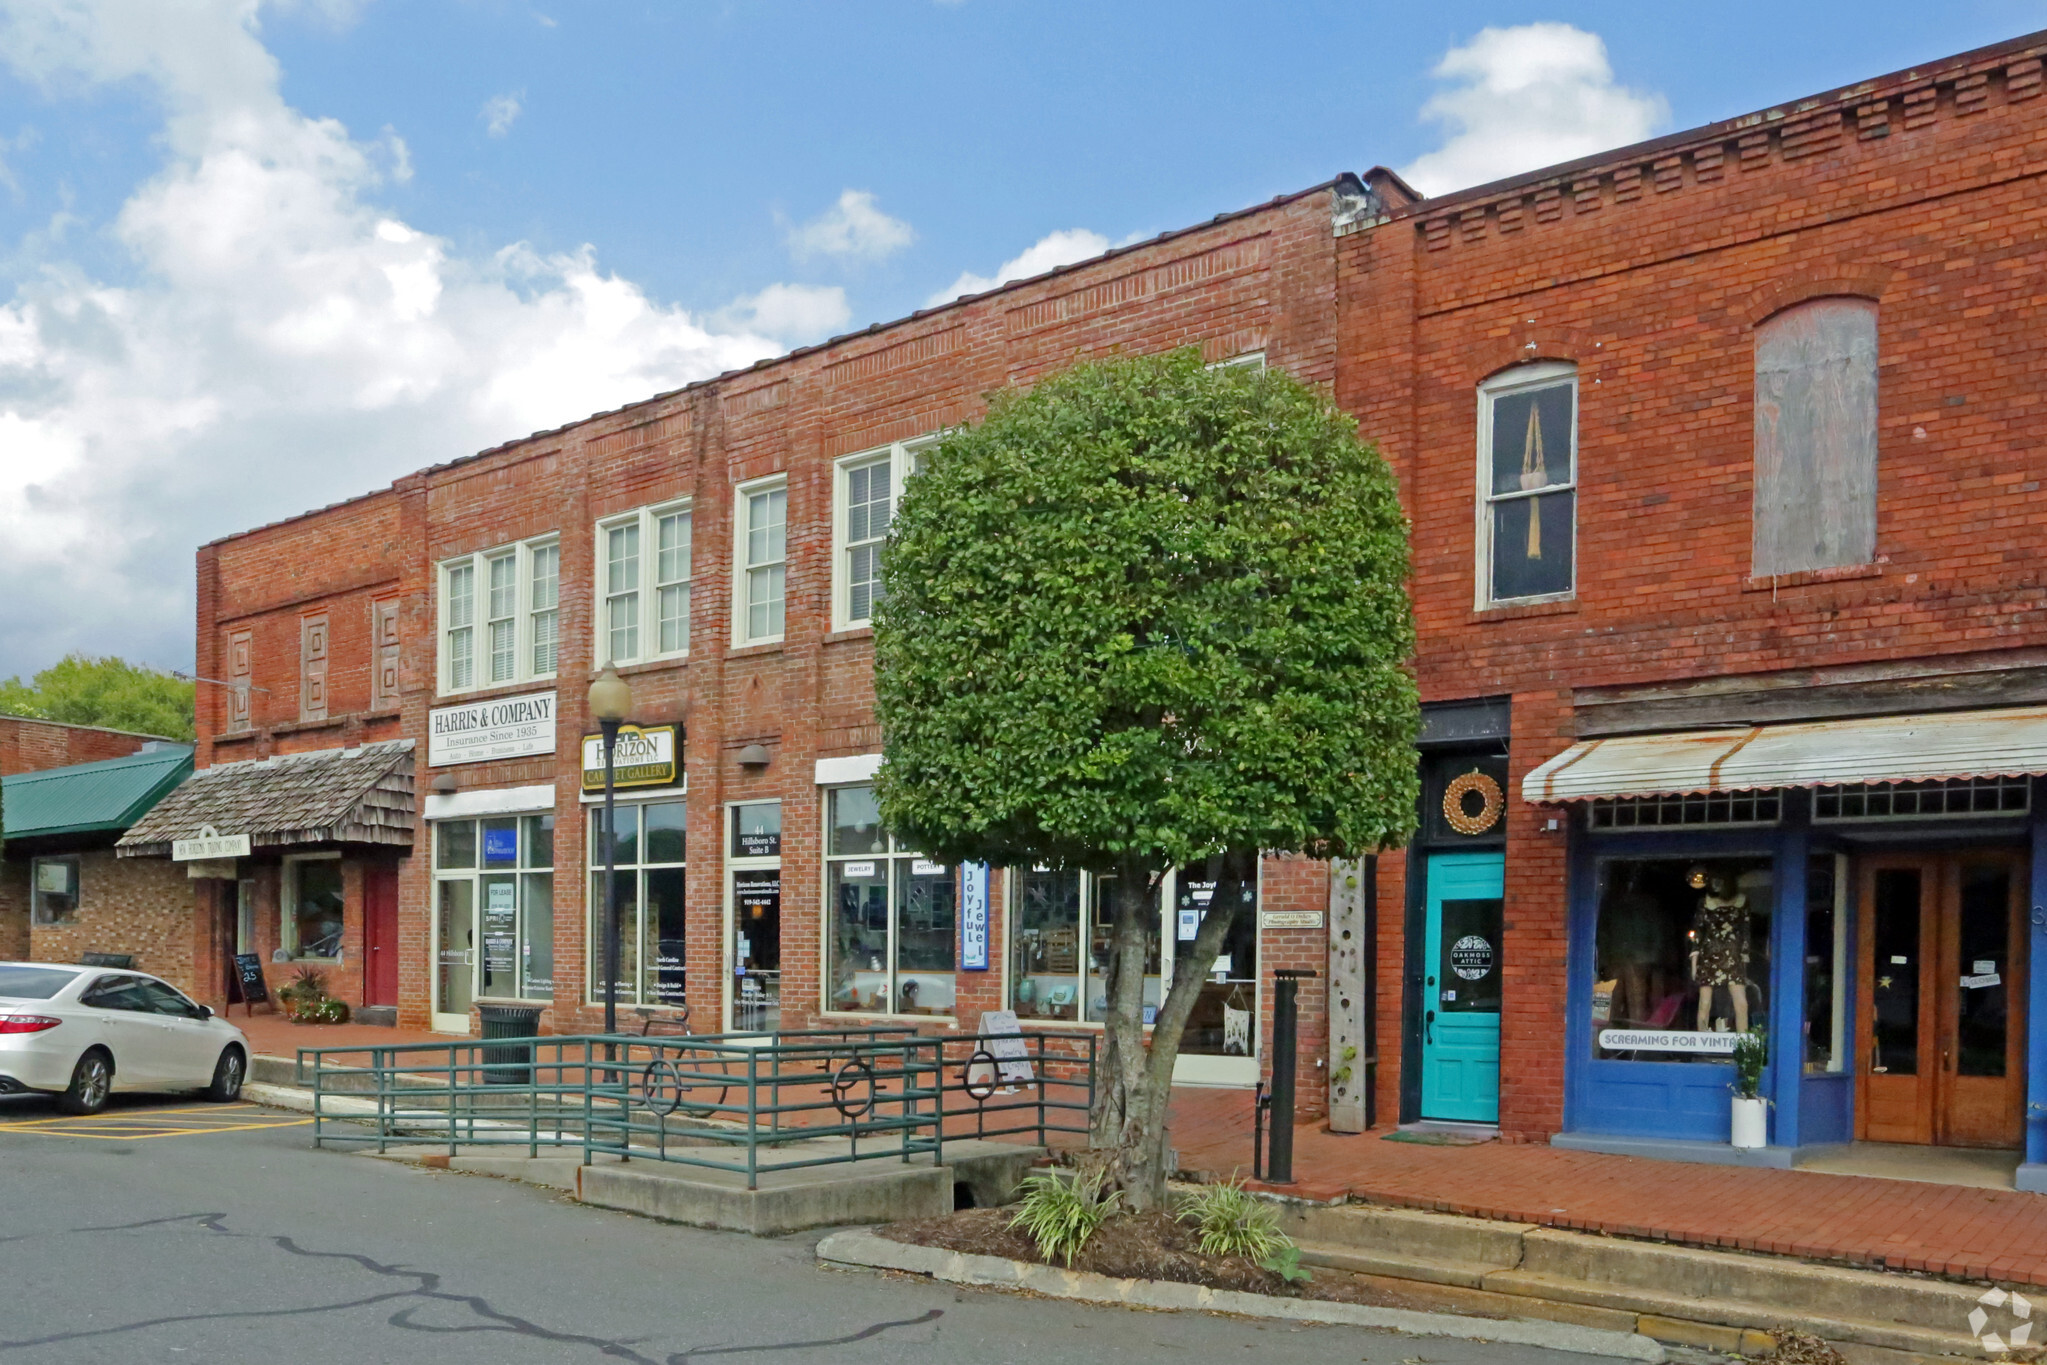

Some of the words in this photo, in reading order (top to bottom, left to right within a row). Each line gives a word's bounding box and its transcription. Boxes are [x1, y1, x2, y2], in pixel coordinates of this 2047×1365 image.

[435, 709, 478, 733] HARRIS
[480, 707, 489, 728] &
[491, 698, 551, 725] COMPANY
[446, 734, 488, 747] Insurance
[490, 729, 513, 741] Since
[516, 726, 537, 737] 1935
[449, 752, 461, 760] Auto
[468, 749, 483, 758] Home
[522, 743, 533, 751] Life
[646, 754, 659, 762] LLC
[587, 768, 626, 782] CABET
[627, 764, 667, 779] GALLERY
[754, 825, 764, 835] 44
[741, 837, 769, 845] Hillsboro
[769, 835, 777, 844] St.
[749, 846, 763, 854] Suite
[764, 846, 769, 854] B
[1188, 881, 1201, 889] The
[966, 870, 974, 942] Joyful
[974, 899, 985, 956] Jewel
[1605, 1034, 1669, 1046] SCREAMING
[1672, 1036, 1697, 1047] FOR
